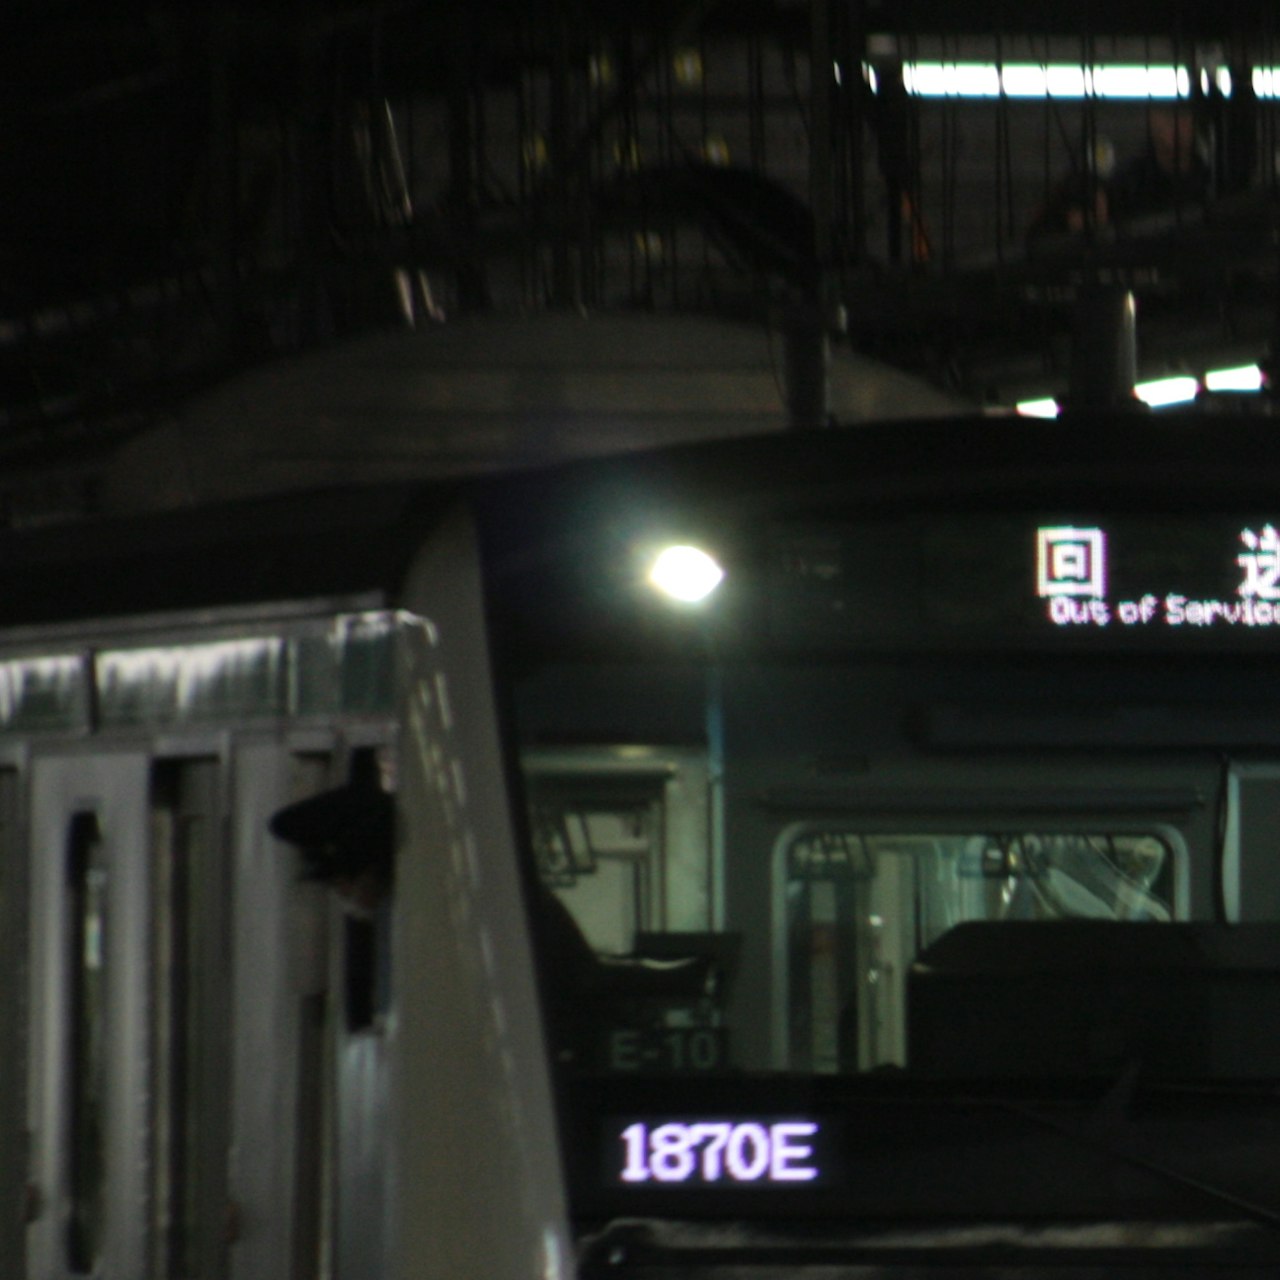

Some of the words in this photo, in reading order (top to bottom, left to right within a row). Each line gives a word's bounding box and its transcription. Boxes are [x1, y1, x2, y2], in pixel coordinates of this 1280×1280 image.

[1049, 596, 1111, 626] Out
[1119, 594, 1157, 625] of
[619, 1121, 819, 1182] 1870E
